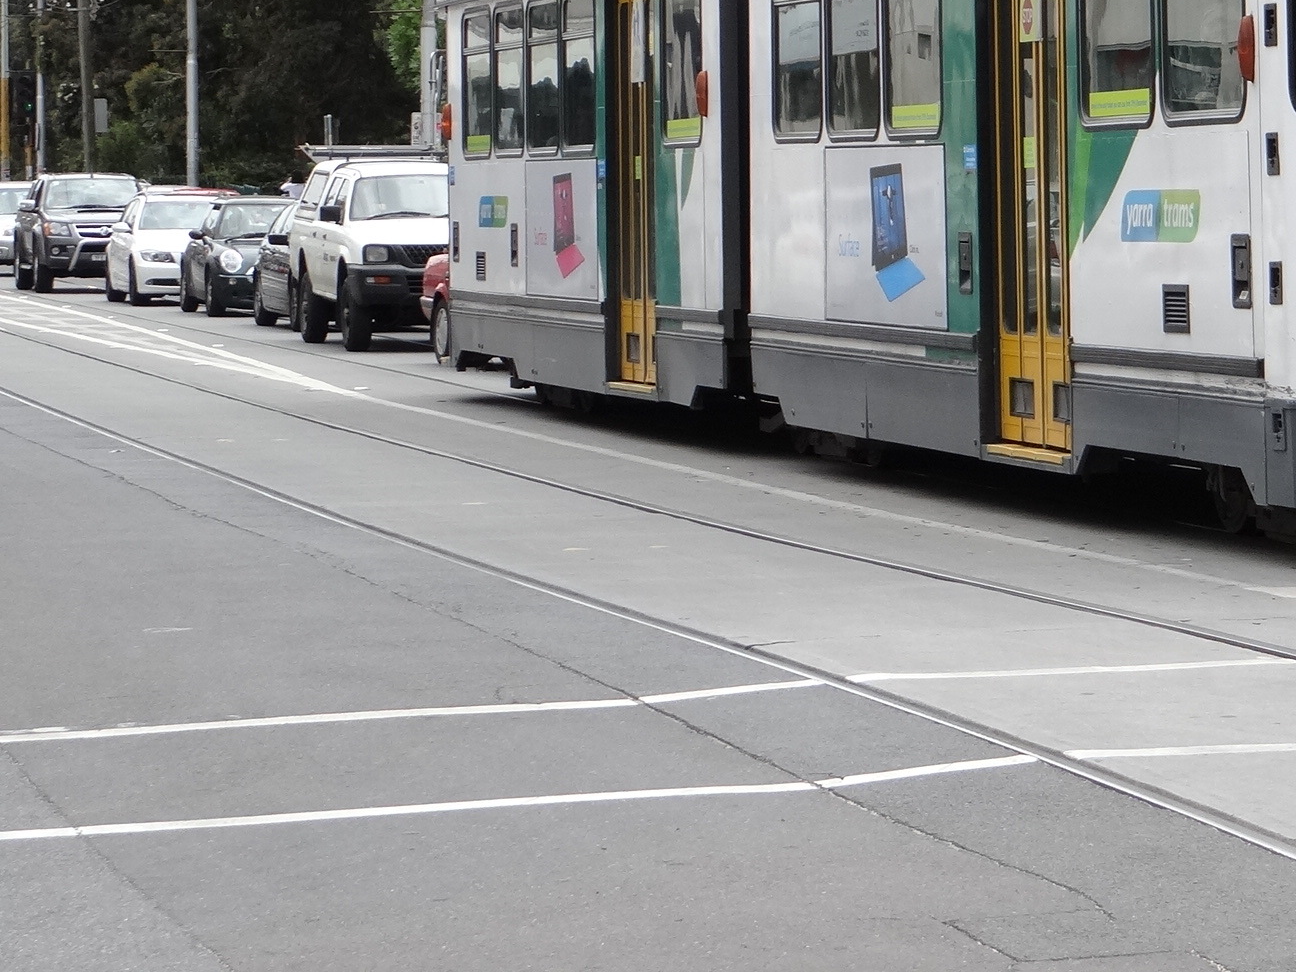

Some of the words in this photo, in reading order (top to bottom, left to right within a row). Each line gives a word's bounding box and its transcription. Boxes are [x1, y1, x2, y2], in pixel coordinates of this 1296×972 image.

[1126, 204, 1153, 235] yarra
[1163, 199, 1194, 227] trams
[838, 233, 860, 257] Surface
